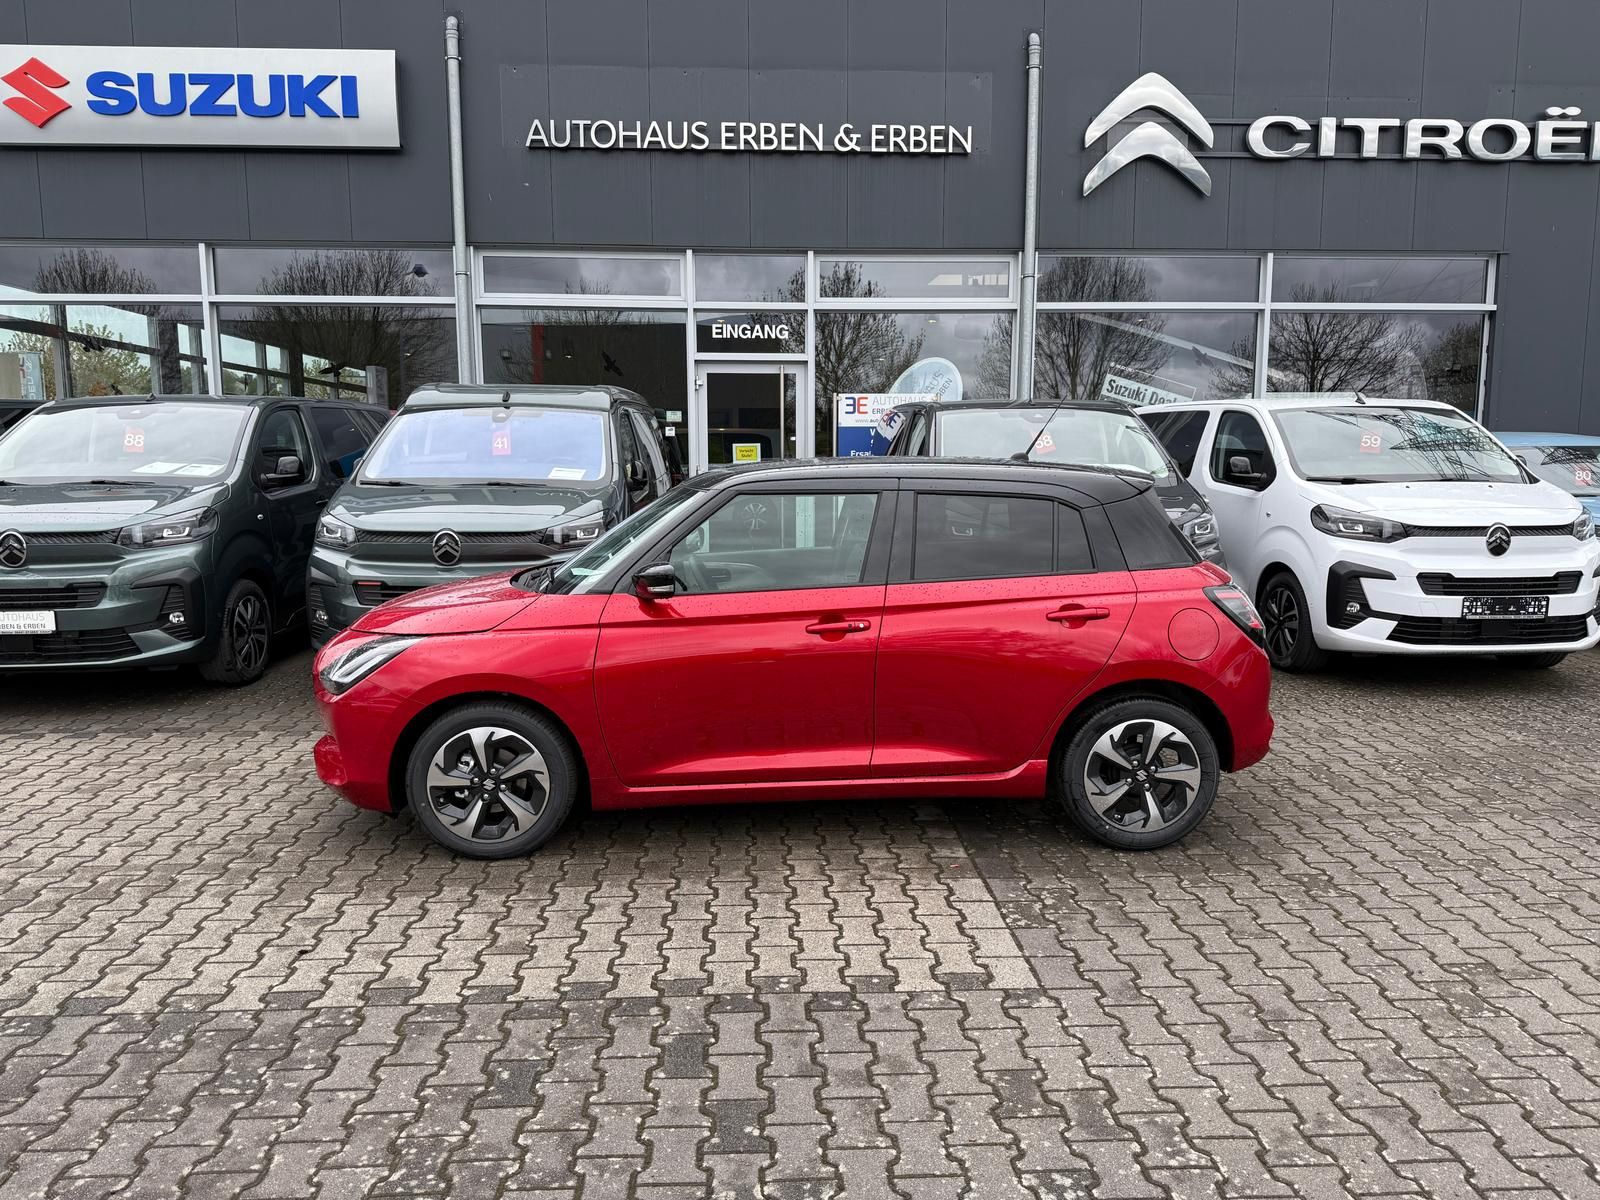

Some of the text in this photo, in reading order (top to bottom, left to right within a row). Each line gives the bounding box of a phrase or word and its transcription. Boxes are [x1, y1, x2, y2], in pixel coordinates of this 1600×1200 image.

[86, 70, 359, 118] SUZUKI
[525, 118, 973, 153] AUTOHAUS ERBEN & ERBEN
[1247, 106, 1600, 160] CITROË
[711, 322, 789, 340] EINGANG
[1106, 378, 1149, 402] Suzuki
[124, 433, 145, 447] 88
[494, 437, 508, 449] 41
[1360, 435, 1382, 448] 59
[1575, 470, 1591, 481] 80
